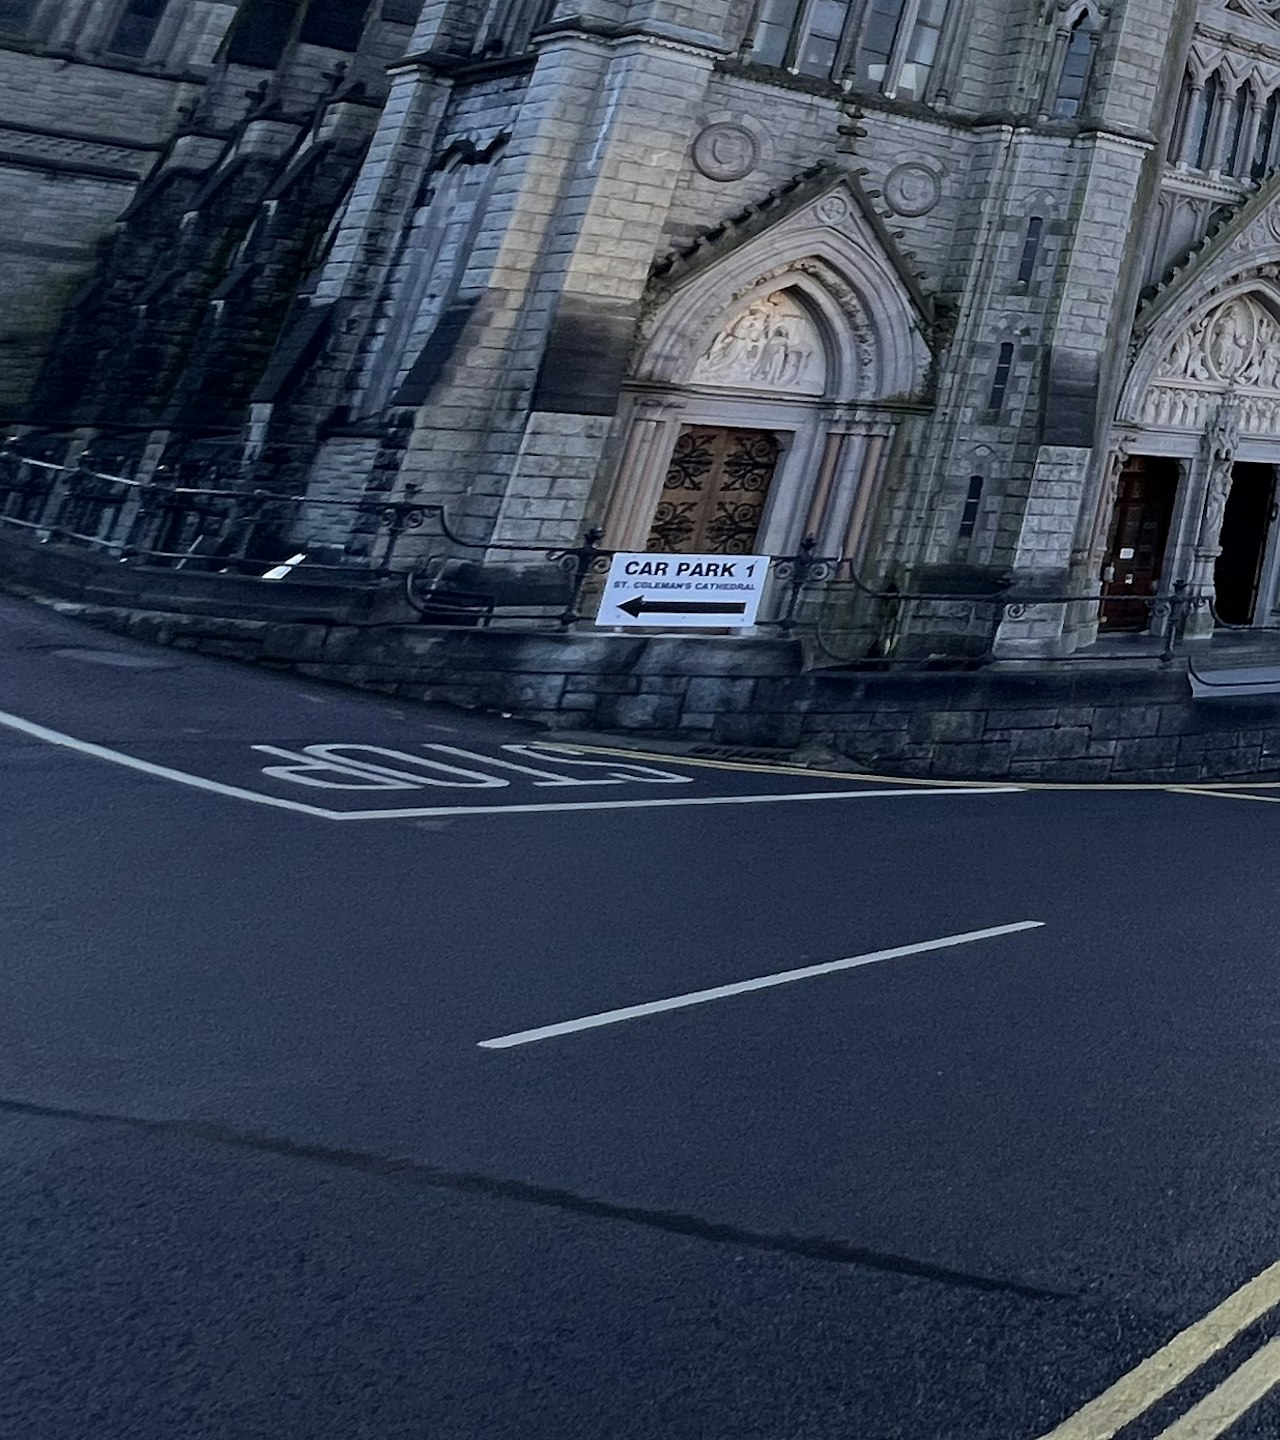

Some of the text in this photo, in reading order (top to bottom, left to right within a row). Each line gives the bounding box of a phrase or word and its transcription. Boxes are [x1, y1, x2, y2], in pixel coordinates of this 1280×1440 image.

[625, 561, 755, 577] CAR PARK 1
[613, 580, 631, 589] ST.
[695, 582, 756, 592] CATHEDRAL
[251, 743, 694, 790] STOP
